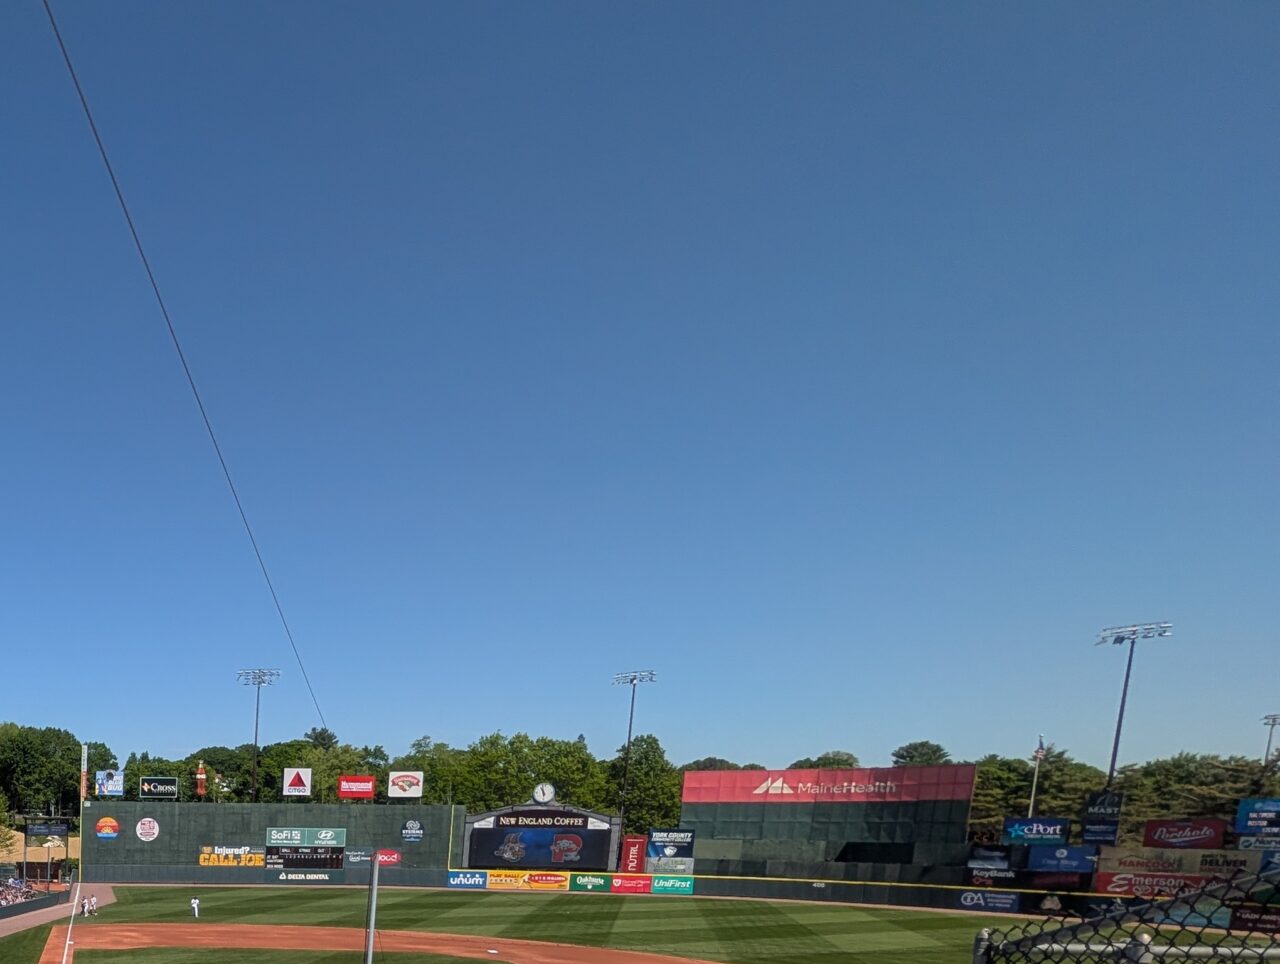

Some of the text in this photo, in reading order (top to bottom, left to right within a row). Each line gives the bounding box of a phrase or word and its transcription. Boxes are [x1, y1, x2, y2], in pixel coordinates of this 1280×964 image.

[797, 781, 897, 794] MaineHealth
[499, 816, 517, 825] NEW
[518, 816, 553, 825] ENGLAND
[554, 816, 585, 826] COFFEE
[1024, 823, 1062, 834] cPort
[271, 830, 291, 840] SoFi
[214, 846, 250, 855] Injured?
[199, 853, 265, 866] CALL JOE
[1200, 859, 1247, 868] DELIVER
[972, 869, 1016, 878] KeyBank
[654, 879, 691, 888] UniFirst
[1107, 873, 1185, 892] Emerson
